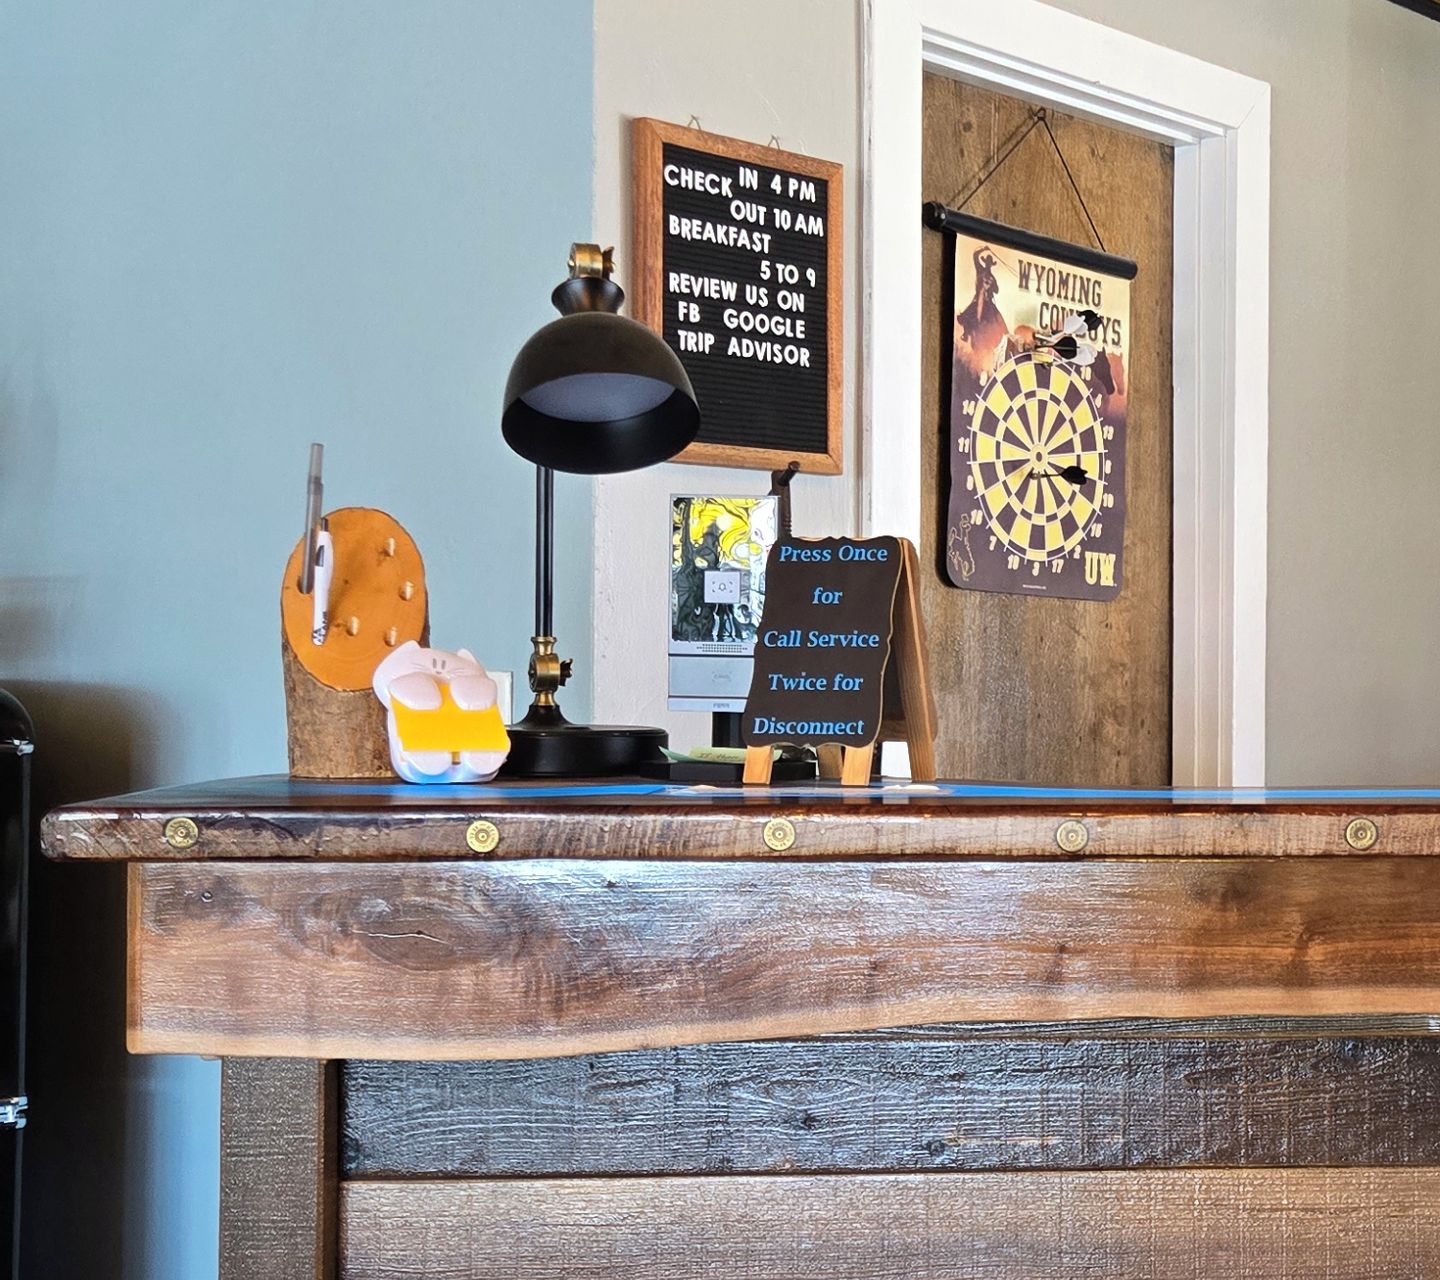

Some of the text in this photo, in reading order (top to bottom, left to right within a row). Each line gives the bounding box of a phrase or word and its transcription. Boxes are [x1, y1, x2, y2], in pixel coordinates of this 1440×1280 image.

[663, 164, 816, 203] CHECK IN 4 PM
[668, 214, 772, 254] BREAKFAST
[730, 199, 824, 237] OUT 10 AM
[760, 259, 816, 288] 5 TO 9
[1017, 258, 1102, 308] WYOMING
[668, 272, 805, 313] REVIEW US ON
[677, 300, 806, 339] FB GOOGLE
[677, 329, 810, 368] TRIP ADVISOR
[779, 545, 888, 562] Press Once
[1084, 551, 1117, 587] UW
[812, 587, 843, 605] for
[763, 629, 880, 648] Call Service
[768, 672, 864, 691] Twice for
[752, 716, 865, 735] Disconnect
